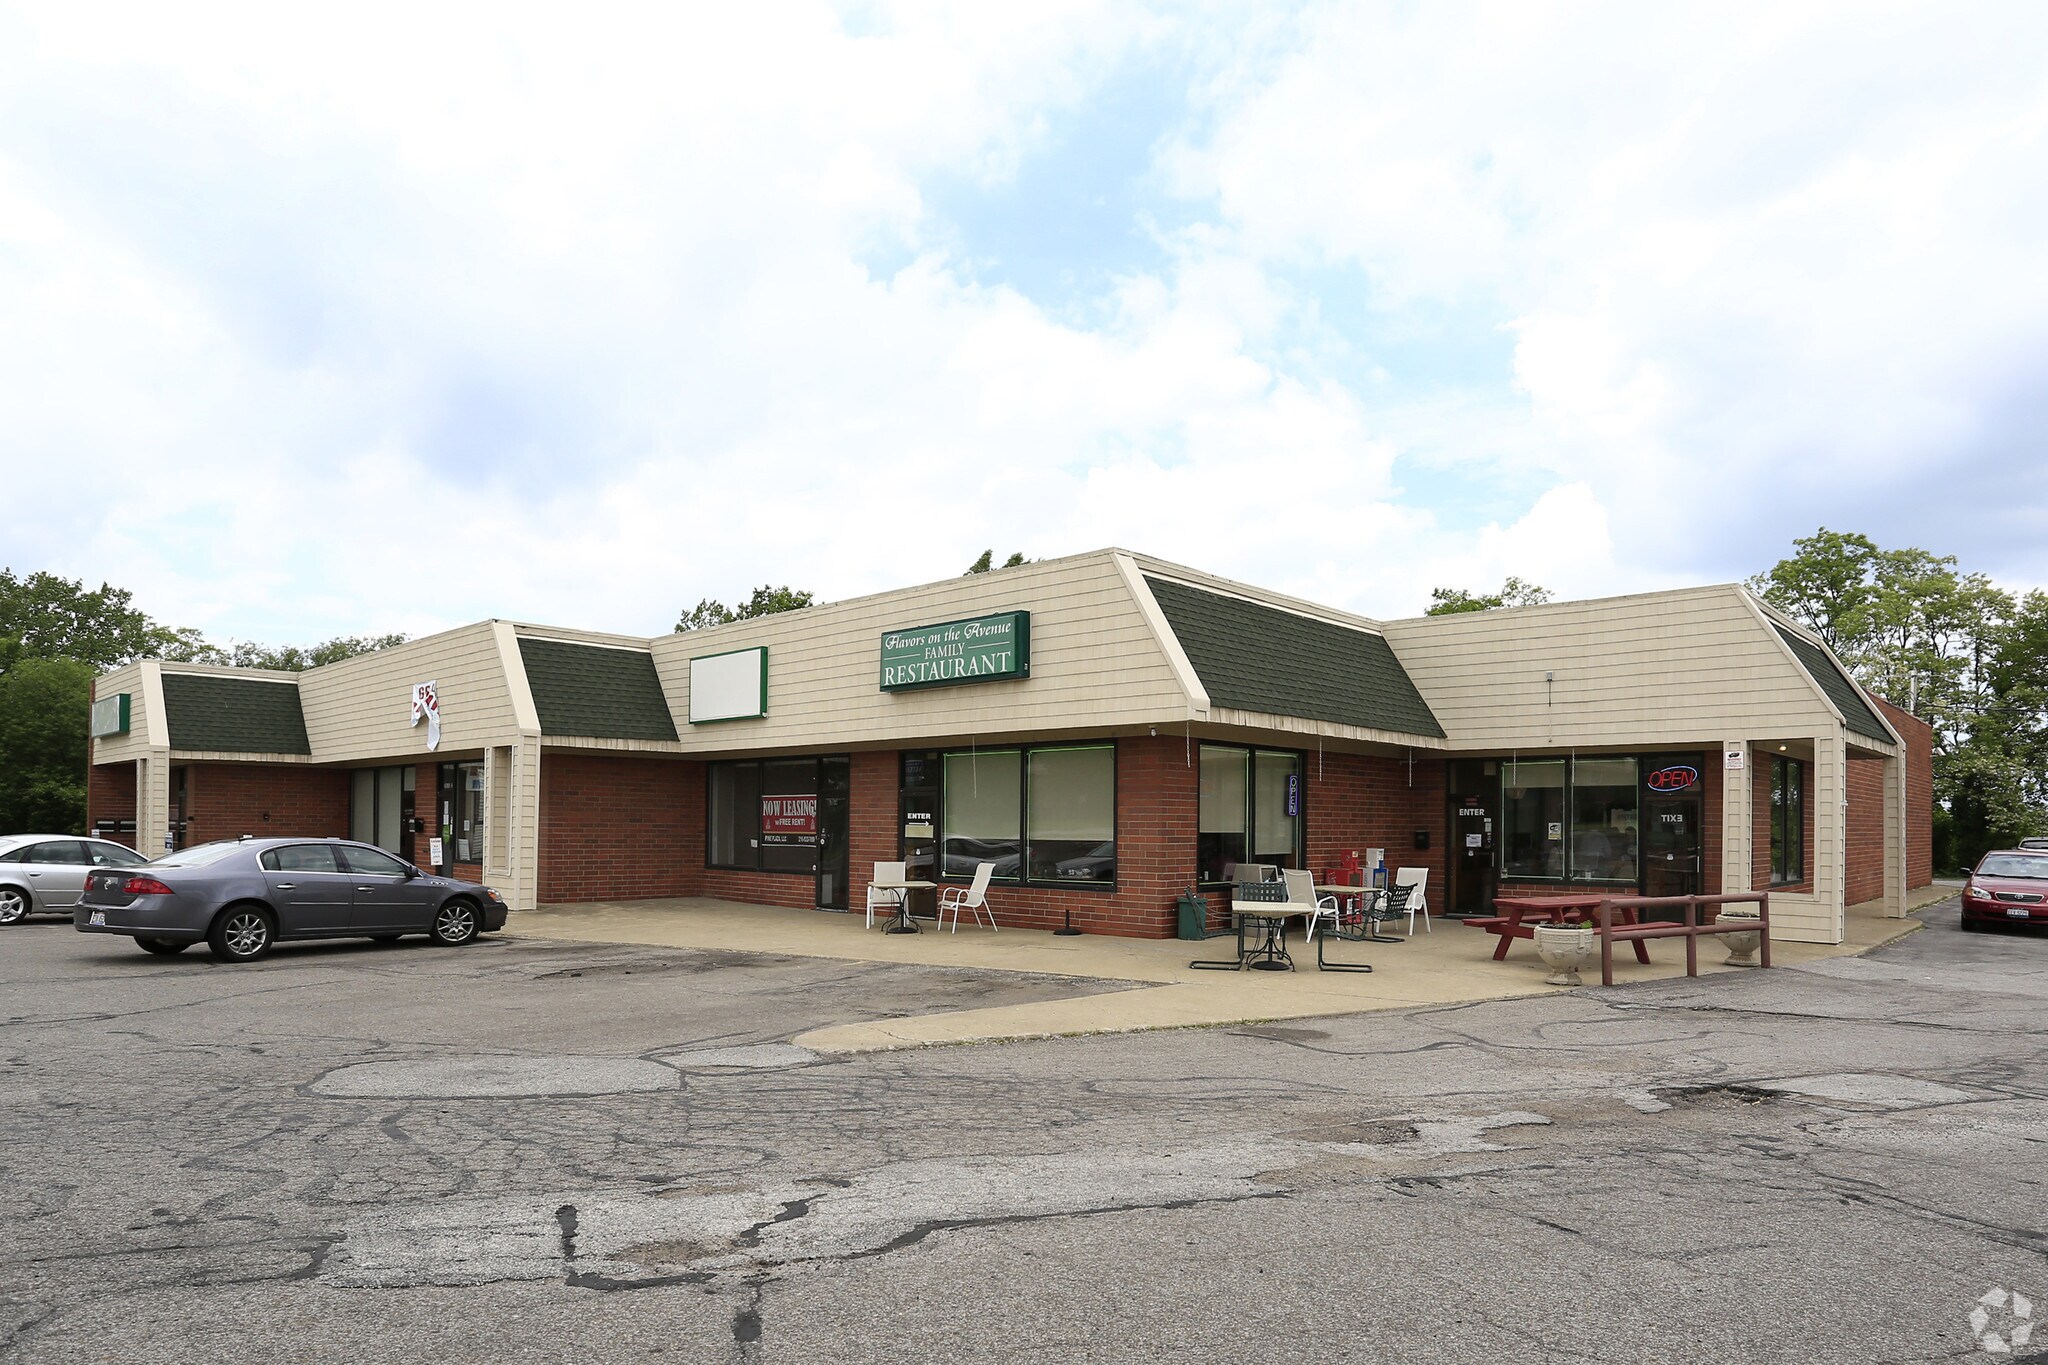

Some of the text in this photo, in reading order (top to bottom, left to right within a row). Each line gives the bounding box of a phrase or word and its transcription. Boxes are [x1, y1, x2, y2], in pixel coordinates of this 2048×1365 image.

[885, 622, 1011, 650] Flavors on the Avenue
[924, 643, 965, 660] FAMILY
[884, 651, 1011, 686] RESTAURANT
[1649, 771, 1694, 787] OPEN
[763, 800, 781, 816] NOW
[783, 800, 817, 817] LEASING!
[907, 812, 931, 820] ENTER
[1459, 808, 1485, 816] ENTER
